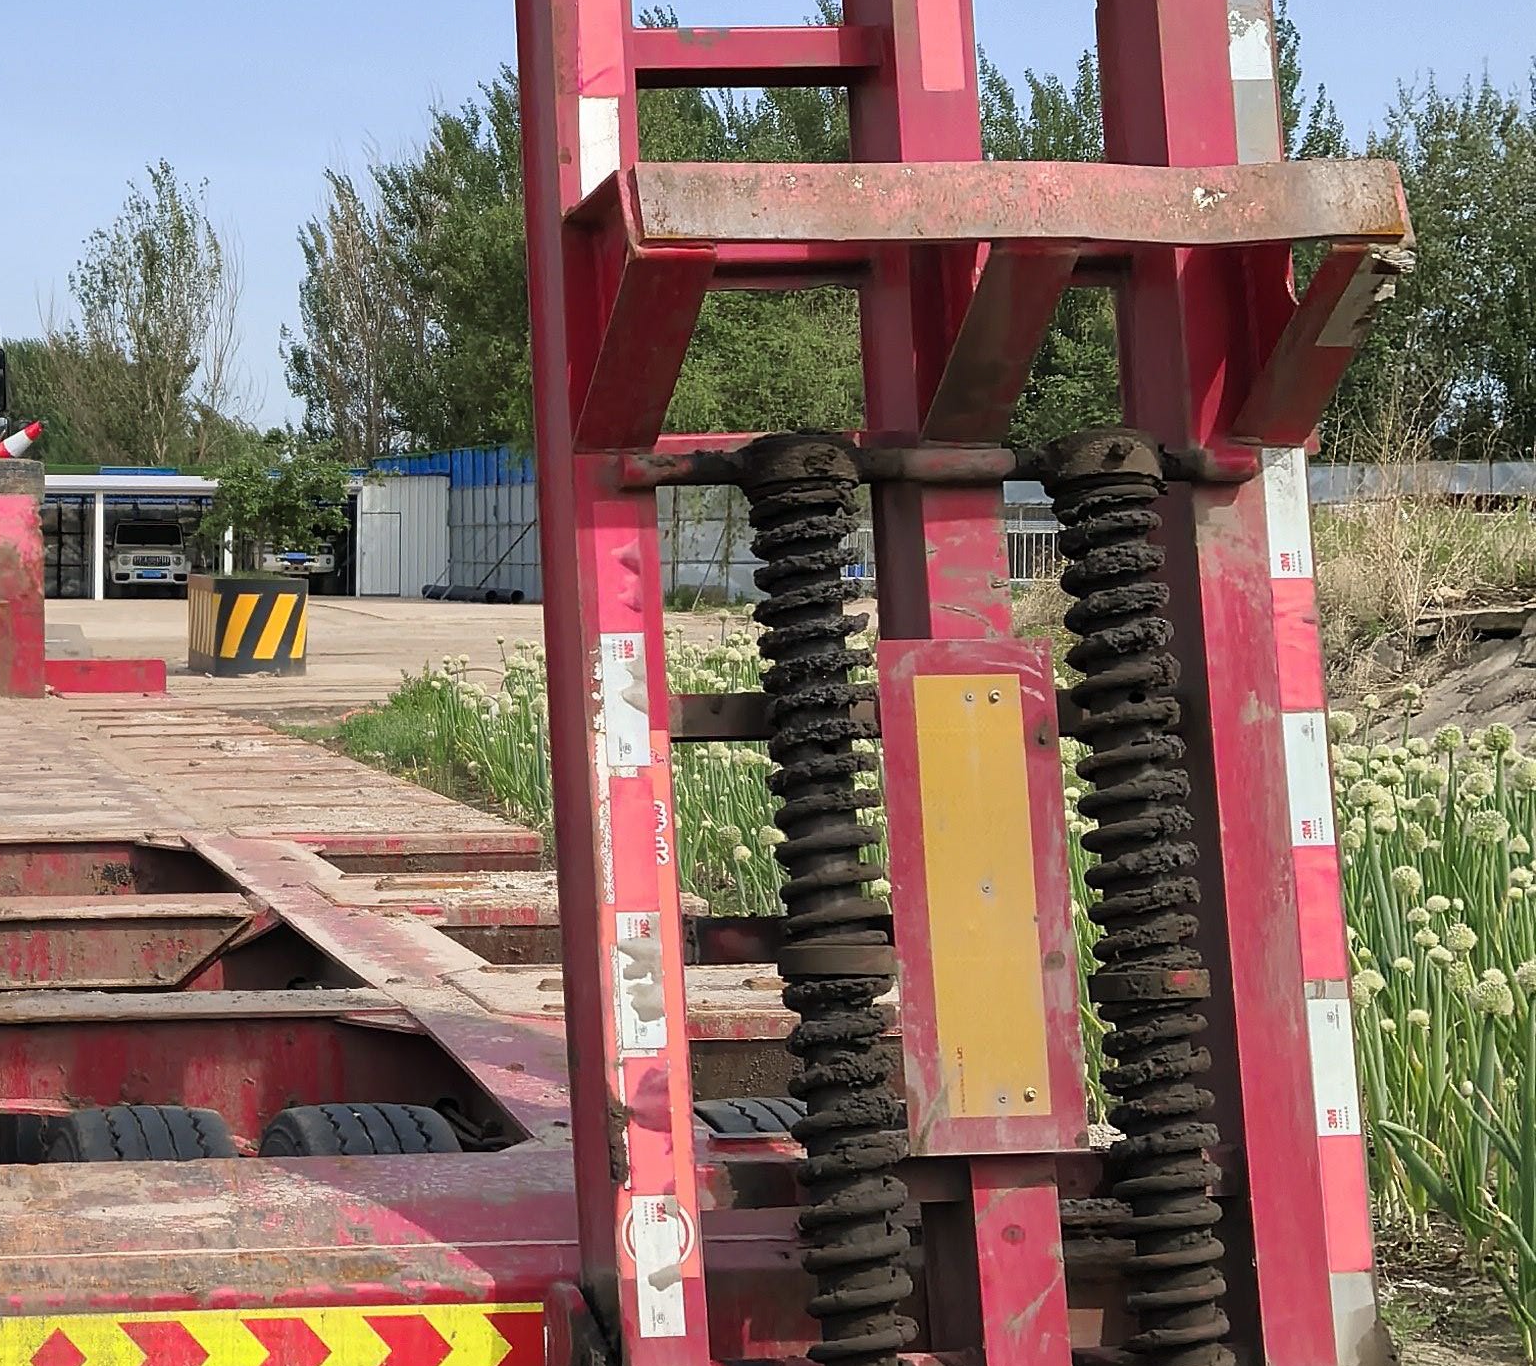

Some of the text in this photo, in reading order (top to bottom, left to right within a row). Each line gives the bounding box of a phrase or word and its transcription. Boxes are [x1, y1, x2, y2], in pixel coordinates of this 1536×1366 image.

[1279, 553, 1291, 572] 3M
[623, 640, 634, 659] 3M
[1301, 820, 1312, 839] 3M
[639, 919, 651, 940] 3M
[1327, 1108, 1339, 1128] 3M
[655, 1202, 667, 1223] 3M
